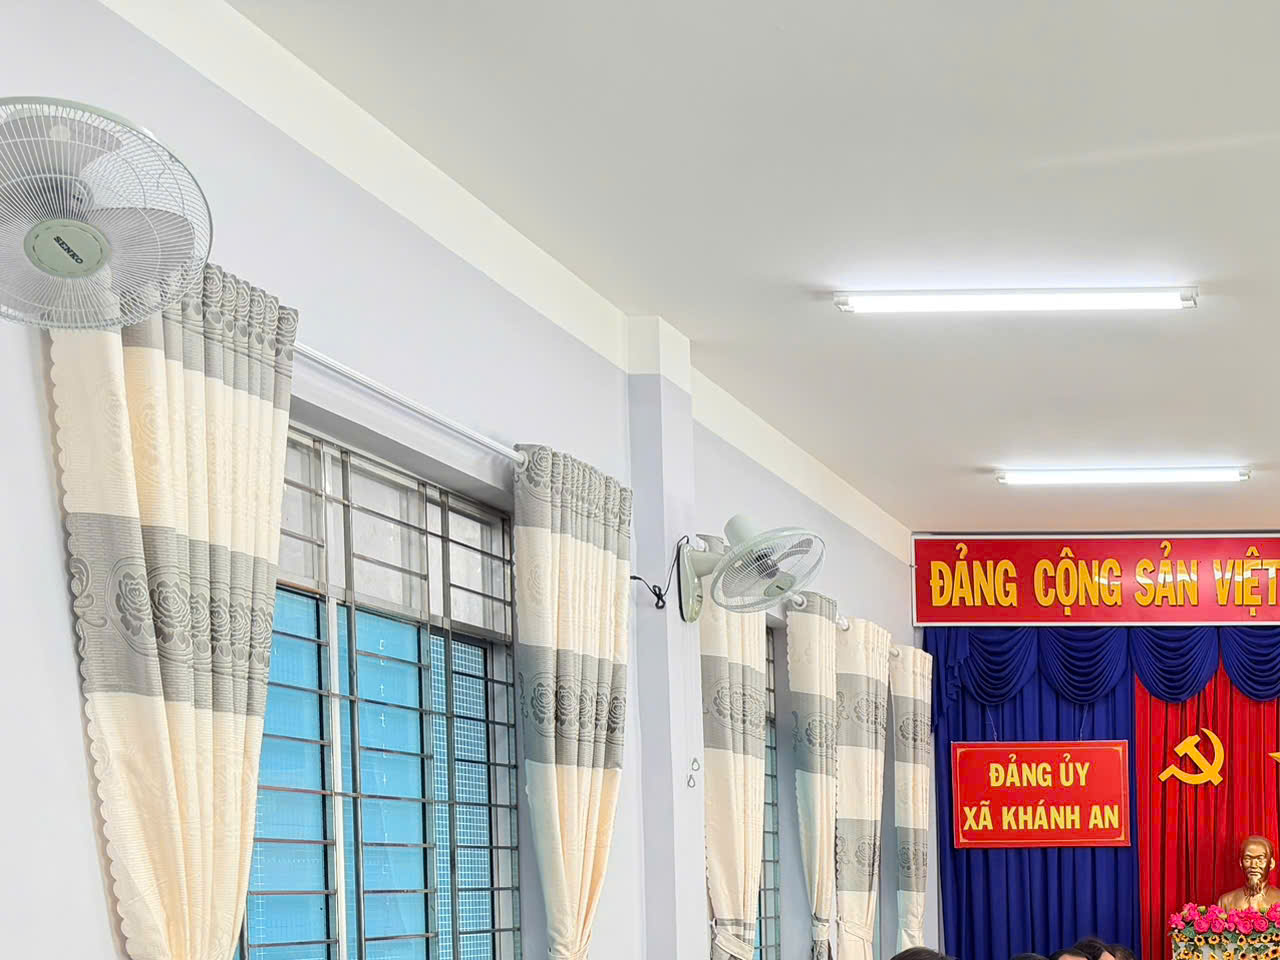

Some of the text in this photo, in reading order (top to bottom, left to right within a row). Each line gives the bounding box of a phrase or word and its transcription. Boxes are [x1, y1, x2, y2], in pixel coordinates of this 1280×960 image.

[53, 236, 84, 264] SENKO
[930, 542, 1018, 607] ĐẢNG
[1034, 546, 1122, 616] CỘNG
[1134, 540, 1199, 606] SẢN
[989, 752, 1091, 787] ĐẢNG ỦY
[963, 799, 1120, 831] XÃ KHÁNH AN
